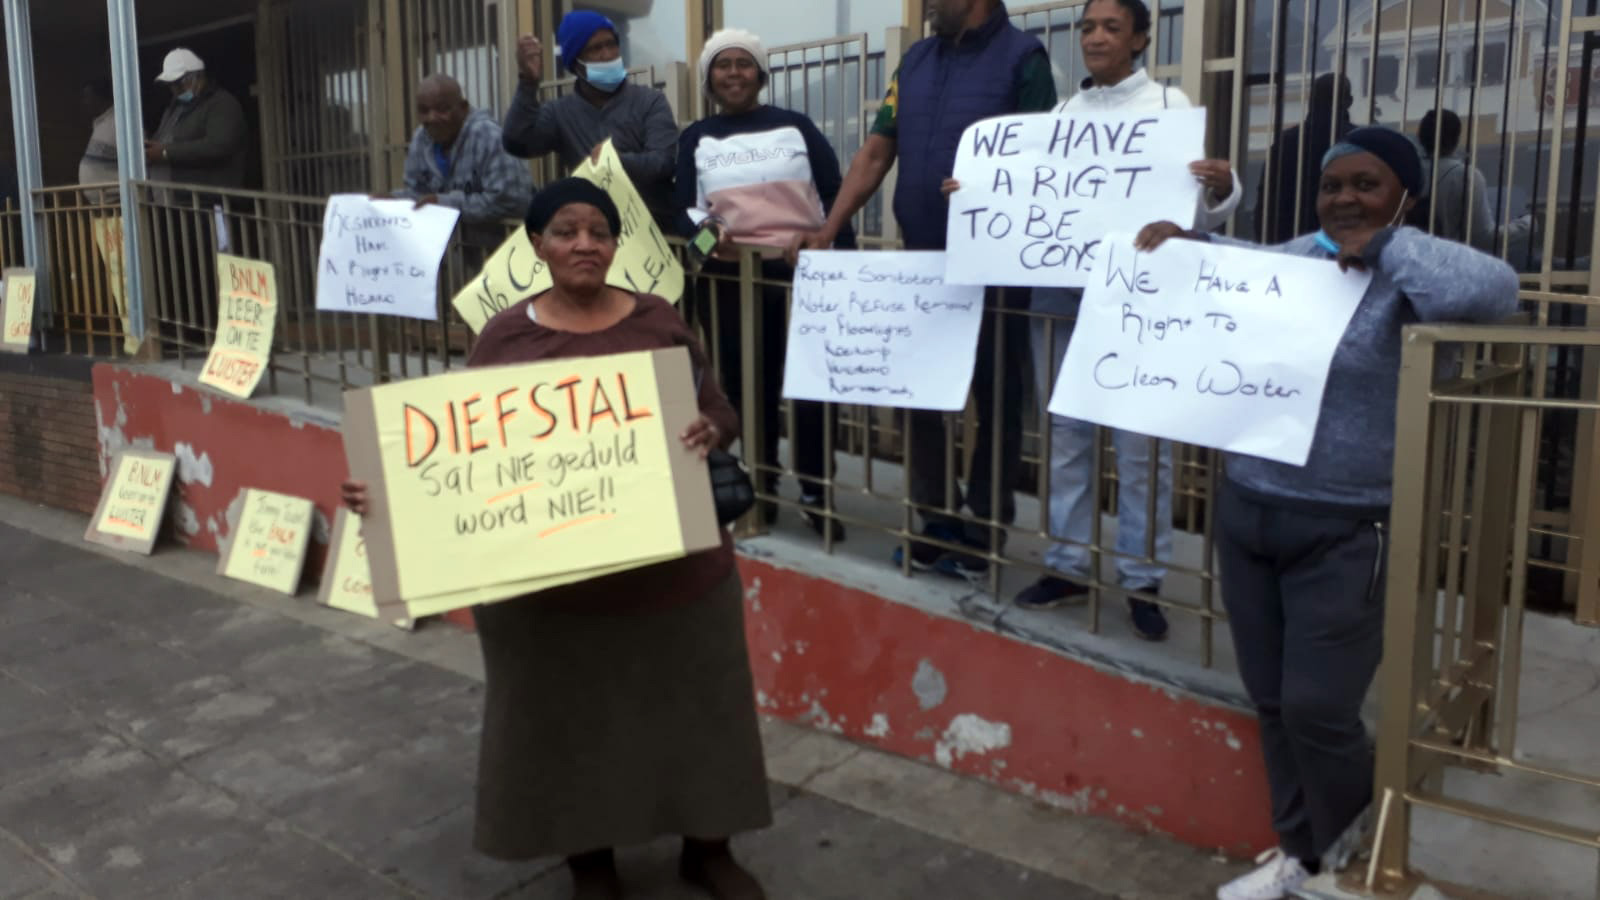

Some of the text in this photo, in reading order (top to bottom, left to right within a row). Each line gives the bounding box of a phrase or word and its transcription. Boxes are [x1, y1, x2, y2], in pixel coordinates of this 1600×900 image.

[973, 118, 1159, 159] WE HAVE
[992, 165, 1152, 200] A RIGT
[960, 204, 1081, 241] TO BE
[1264, 273, 1282, 298] A
[226, 296, 262, 327] LEER
[1093, 352, 1301, 398] Clean Water
[403, 371, 655, 469] DIEFSTAL
[419, 429, 638, 497] Sal NIE geduld
[455, 476, 617, 535] word NIE!!
